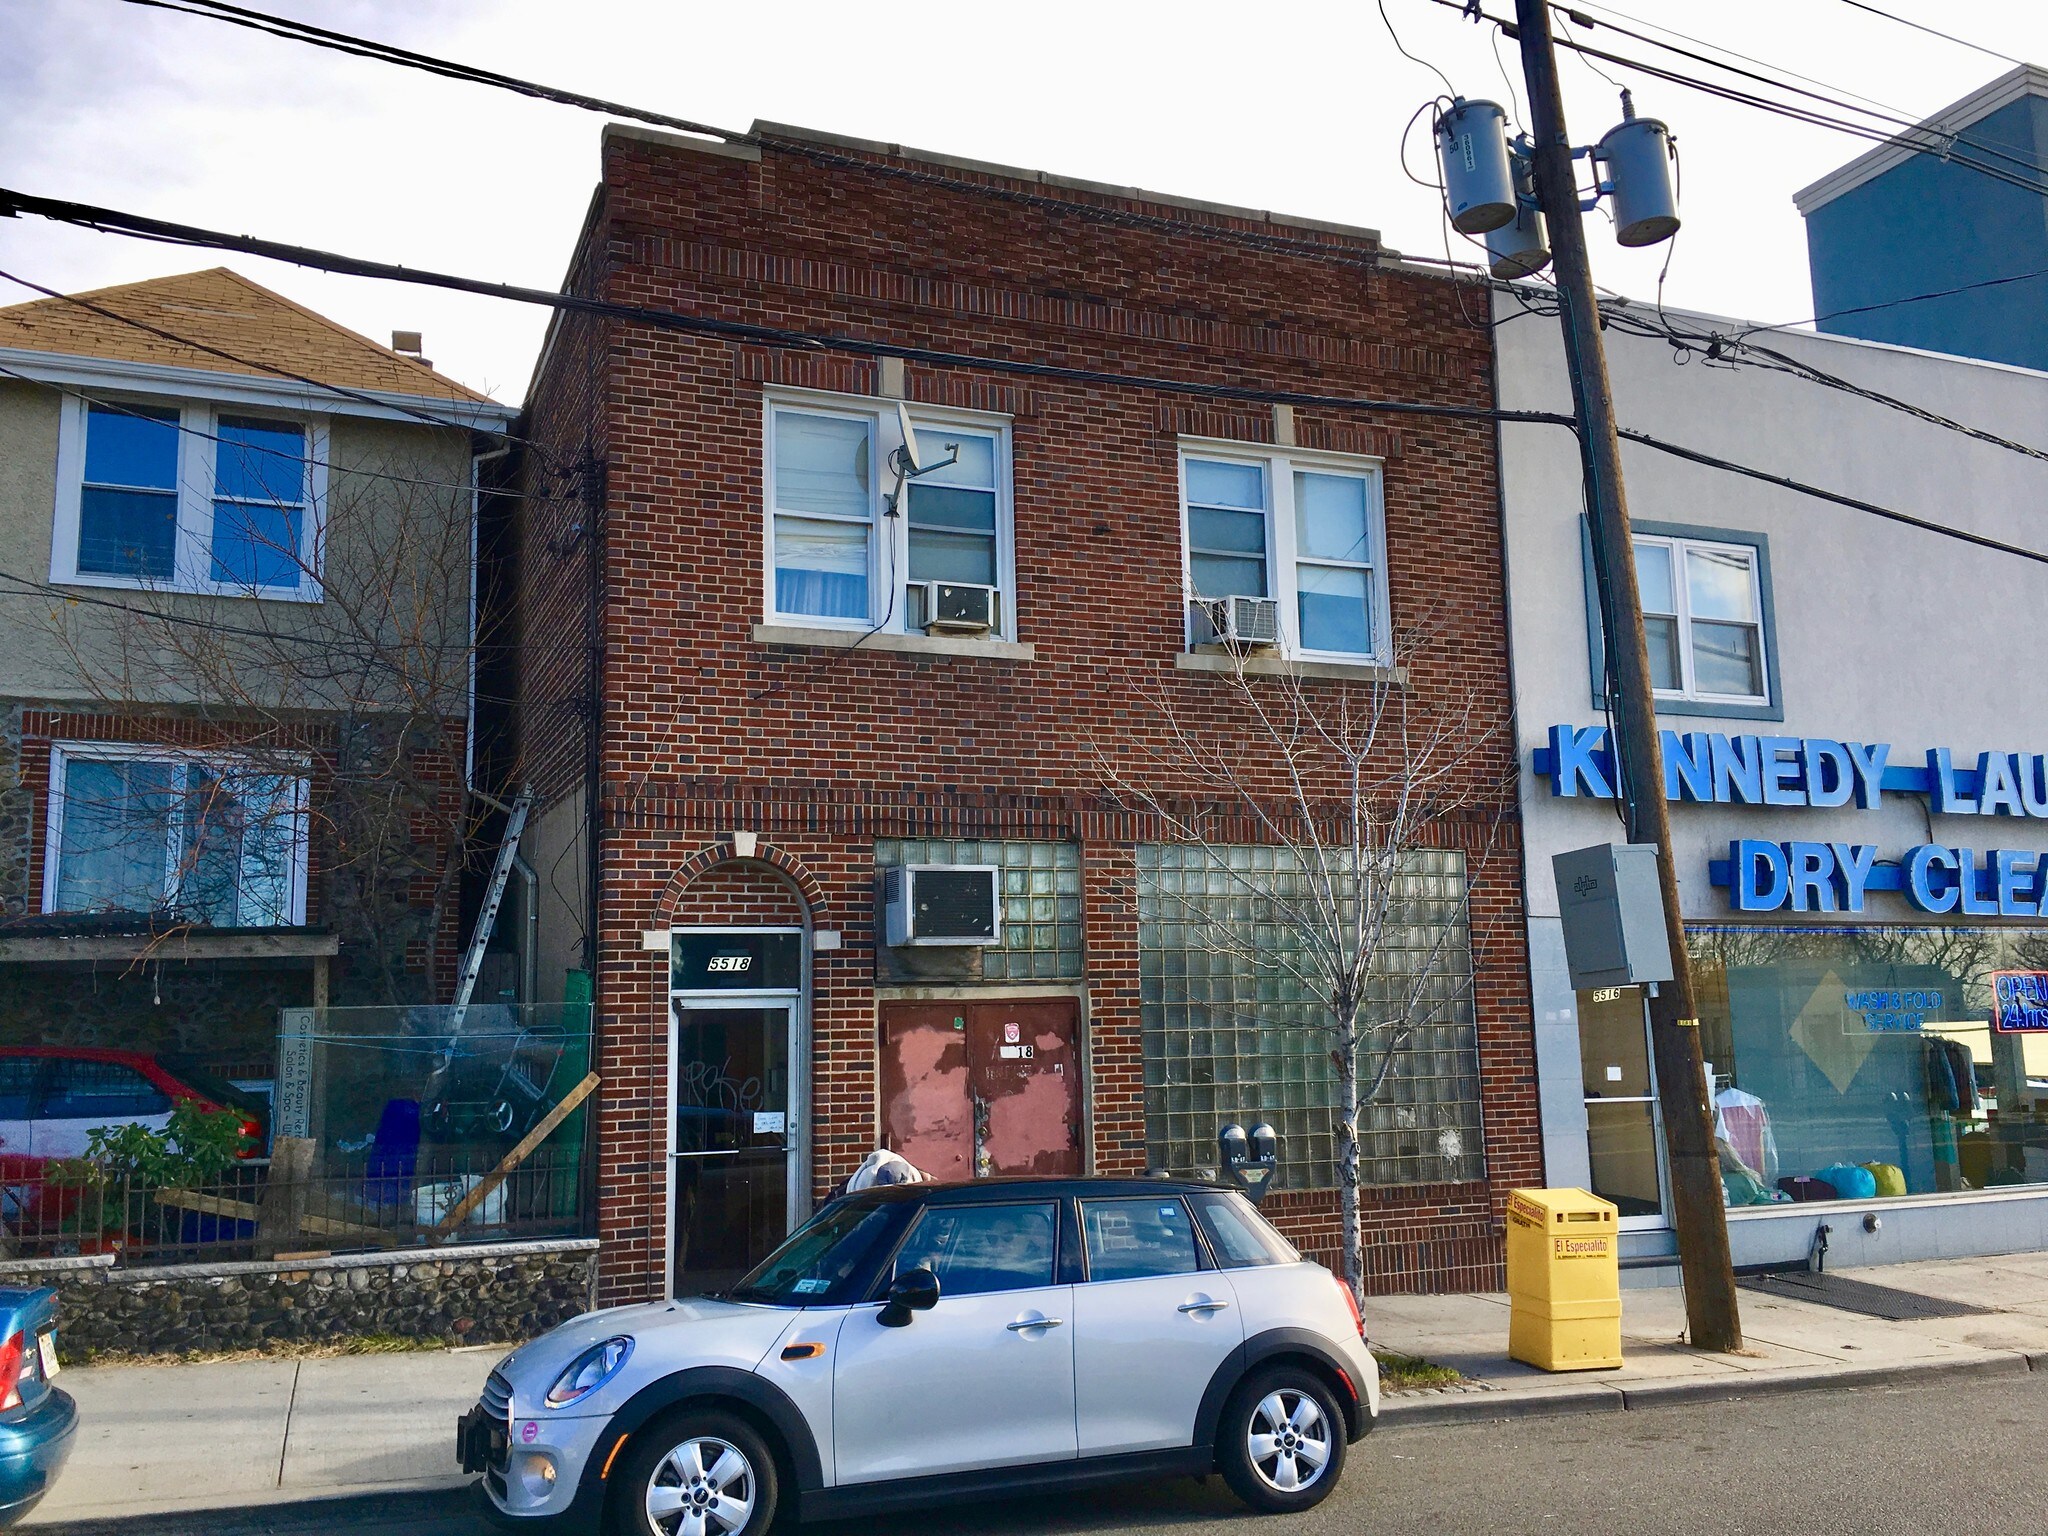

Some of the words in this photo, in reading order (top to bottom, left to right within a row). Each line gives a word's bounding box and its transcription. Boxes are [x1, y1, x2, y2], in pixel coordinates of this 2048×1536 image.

[1549, 725, 1891, 809] KNNEDY
[1574, 875, 1597, 896] alpha
[1730, 839, 1877, 912] DRY
[1902, 843, 2048, 918] CLE
[710, 957, 750, 970] 5518
[1594, 988, 1619, 1001] 5516
[1997, 976, 2048, 1002] OPEN
[1845, 991, 1889, 1010] WASH
[1891, 992, 1901, 1010] &
[1904, 992, 1942, 1009] FOLD
[1865, 1012, 1925, 1031] SERVICE
[1018, 1046, 1032, 1058] 18
[285, 1050, 297, 1079] Salon
[282, 1092, 295, 1112] Spa
[1514, 1197, 1545, 1222] Especialito
[1556, 1240, 1563, 1252] El
[1565, 1239, 1607, 1254] Especialito
